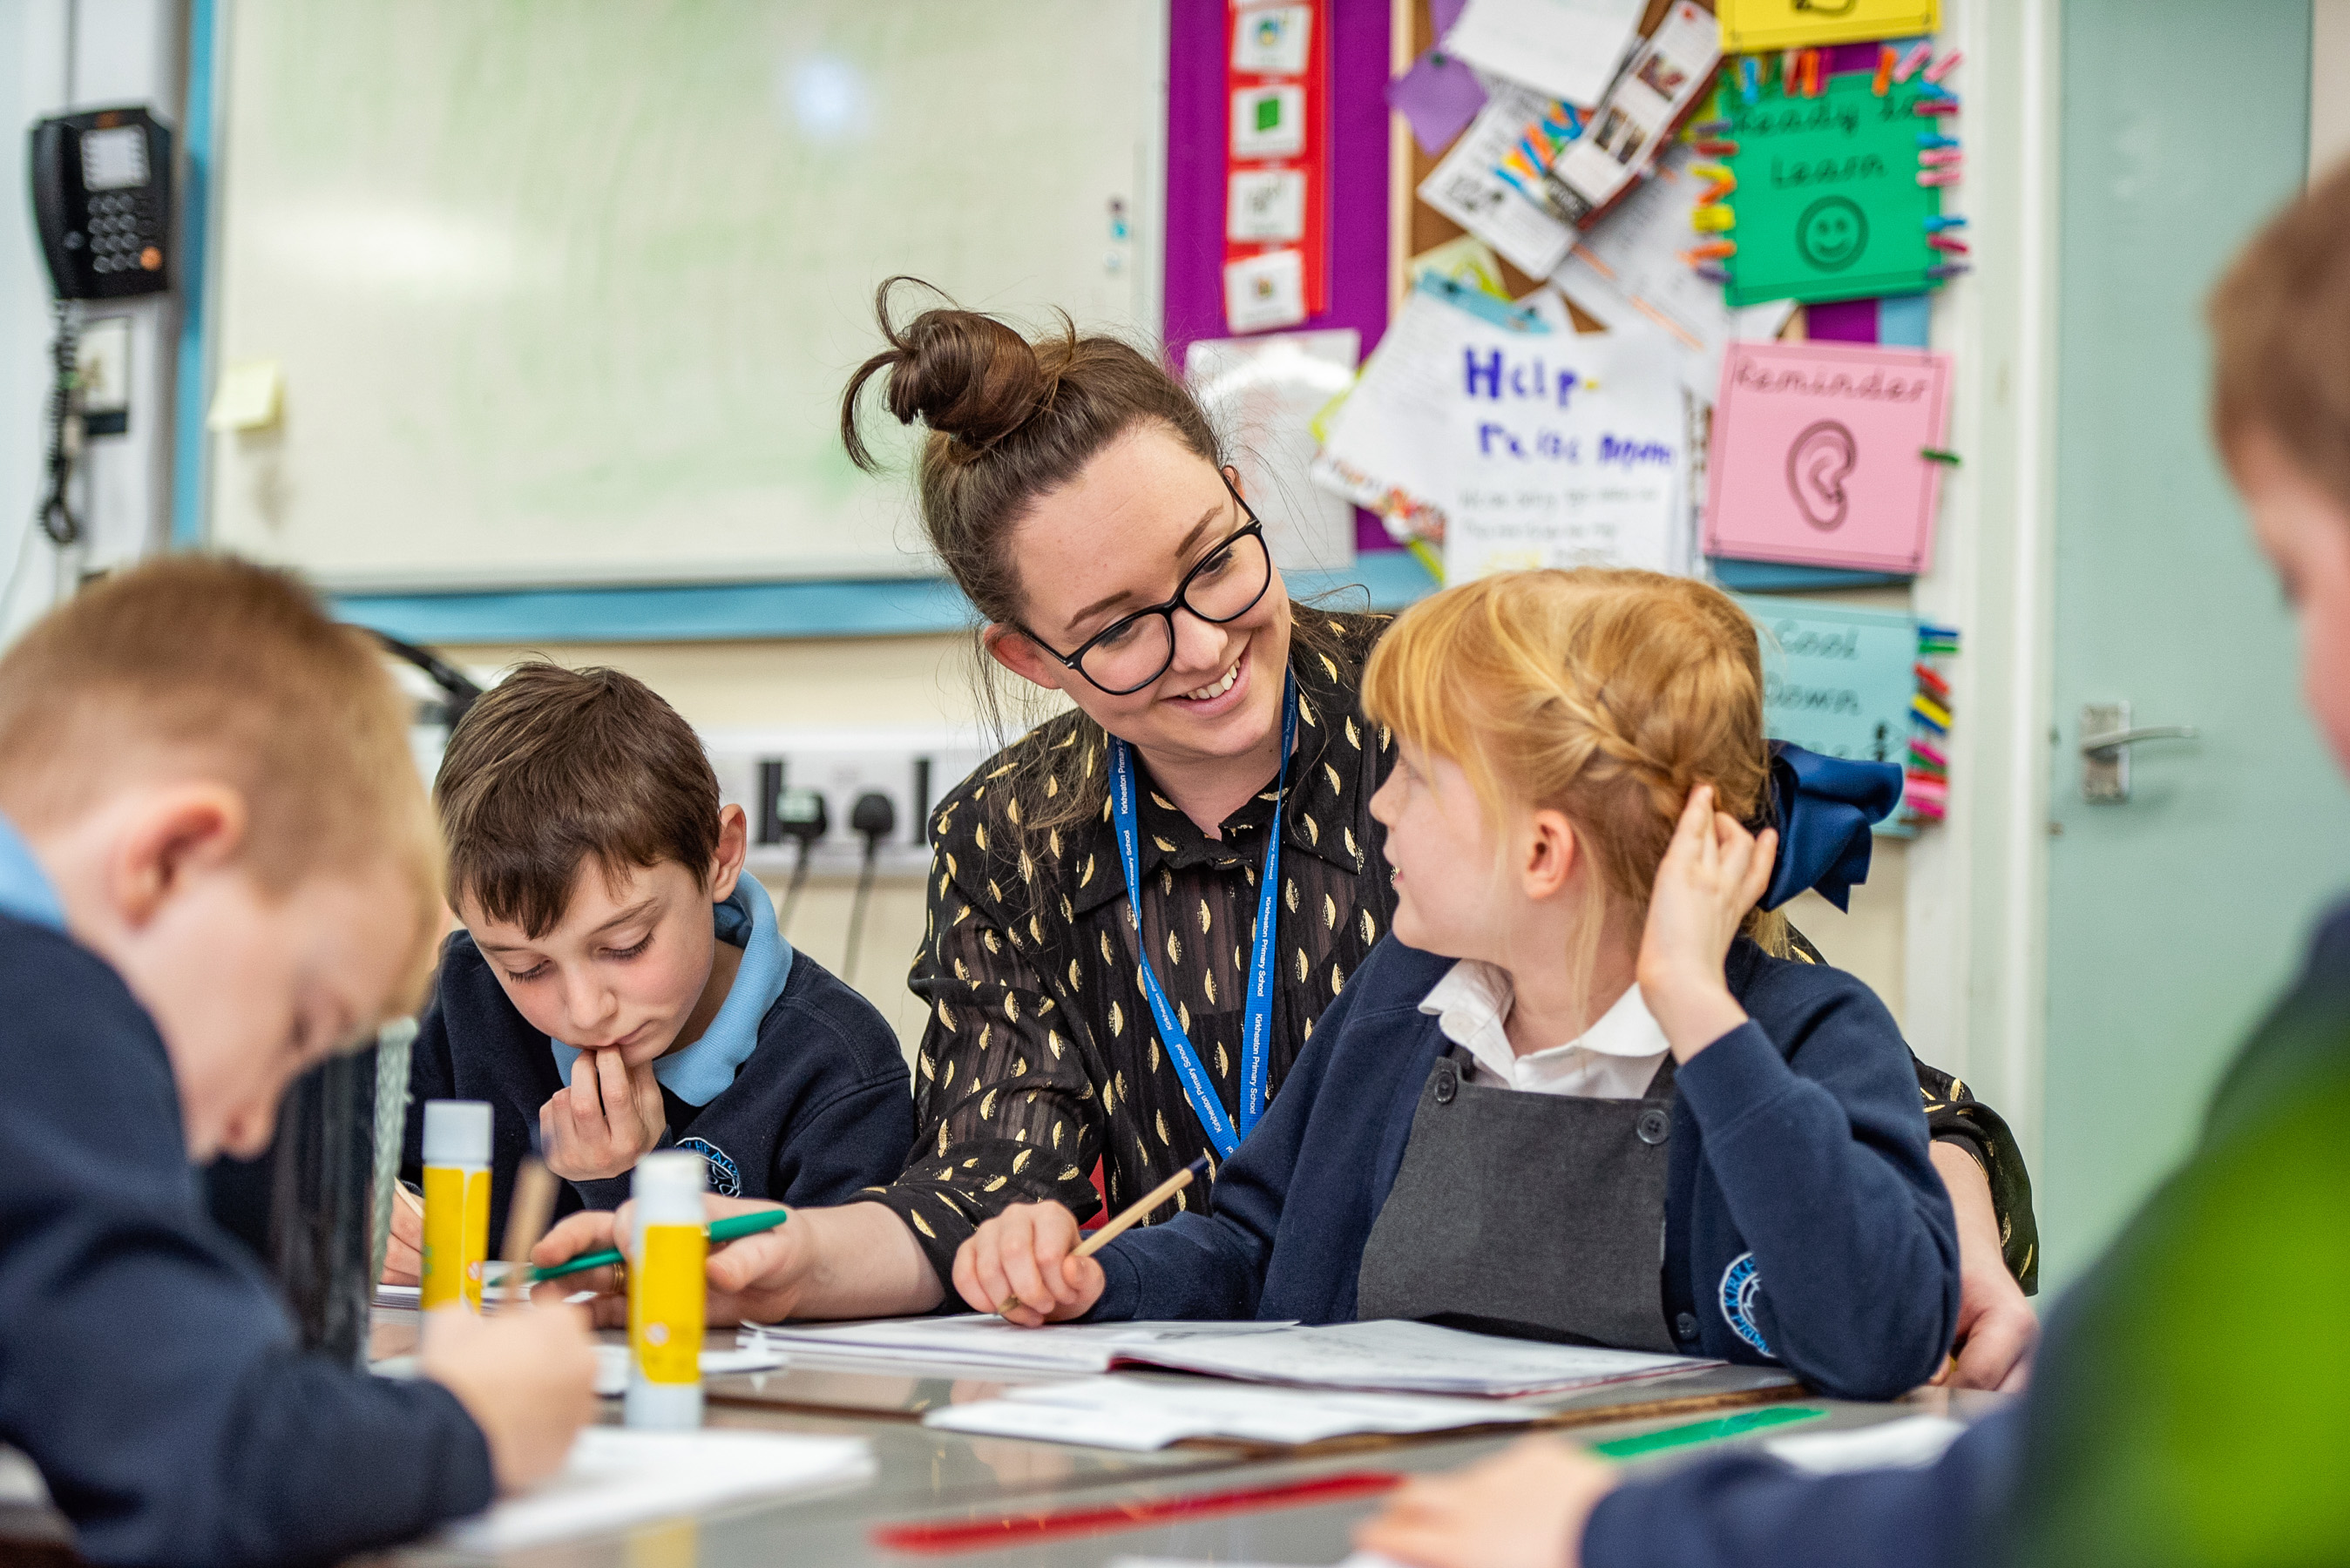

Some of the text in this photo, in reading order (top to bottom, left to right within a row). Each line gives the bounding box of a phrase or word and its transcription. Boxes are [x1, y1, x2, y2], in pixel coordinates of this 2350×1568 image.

[1770, 154, 1887, 190] Learn
[1735, 356, 1928, 402] Reminder
[1774, 619, 1859, 660] Cool
[1764, 671, 1861, 716] Down
[1118, 746, 1127, 774] Primary
[1123, 829, 1132, 855] School
[1256, 896, 1271, 997] Kirkheaton Primary School
[1155, 993, 1173, 1031] Kirkheaton
[1249, 1013, 1263, 1114] Kirkheaton Primary School
[1175, 1044, 1222, 1133] Kirkheaton Primary School
